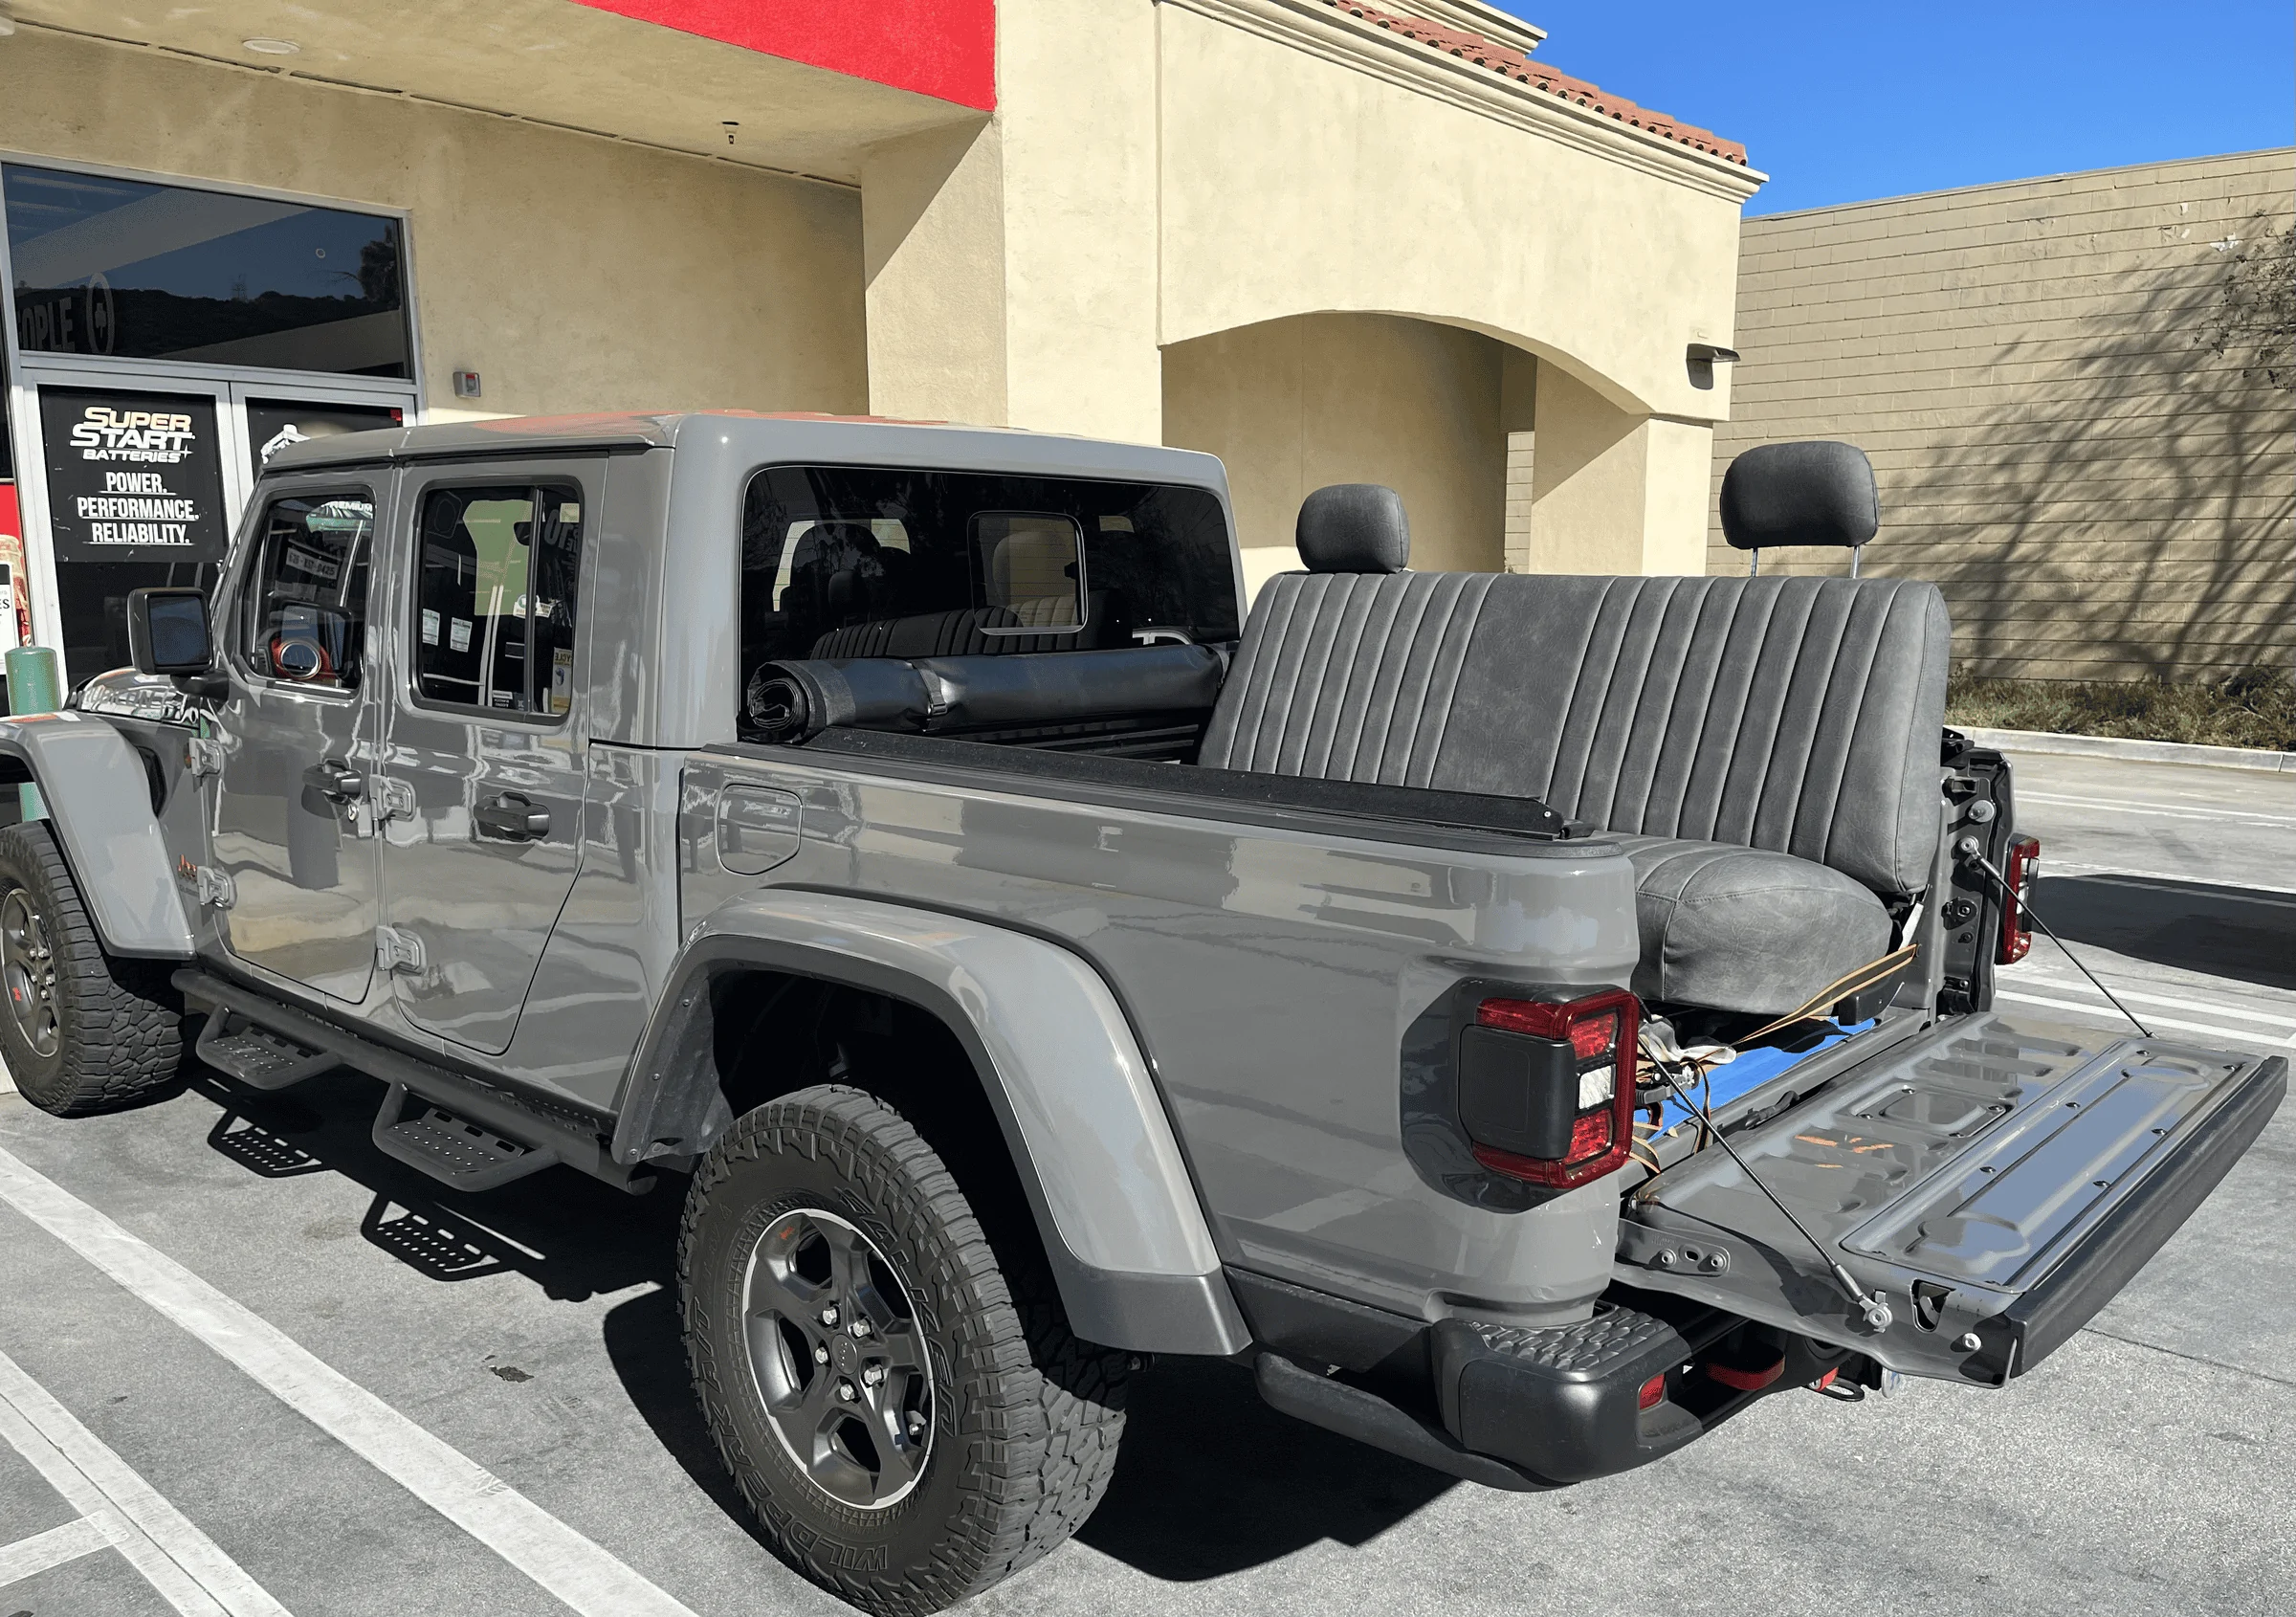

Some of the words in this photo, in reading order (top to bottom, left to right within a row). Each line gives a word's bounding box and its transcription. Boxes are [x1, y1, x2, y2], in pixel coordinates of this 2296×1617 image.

[18, 297, 76, 352] OPLE
[84, 407, 191, 432] SUPER
[70, 423, 193, 451] START
[83, 449, 182, 463] BATTERIES
[105, 472, 167, 494] POWER.
[77, 497, 199, 520] PERFORMANCE.
[91, 522, 190, 543] RELIABILITY.
